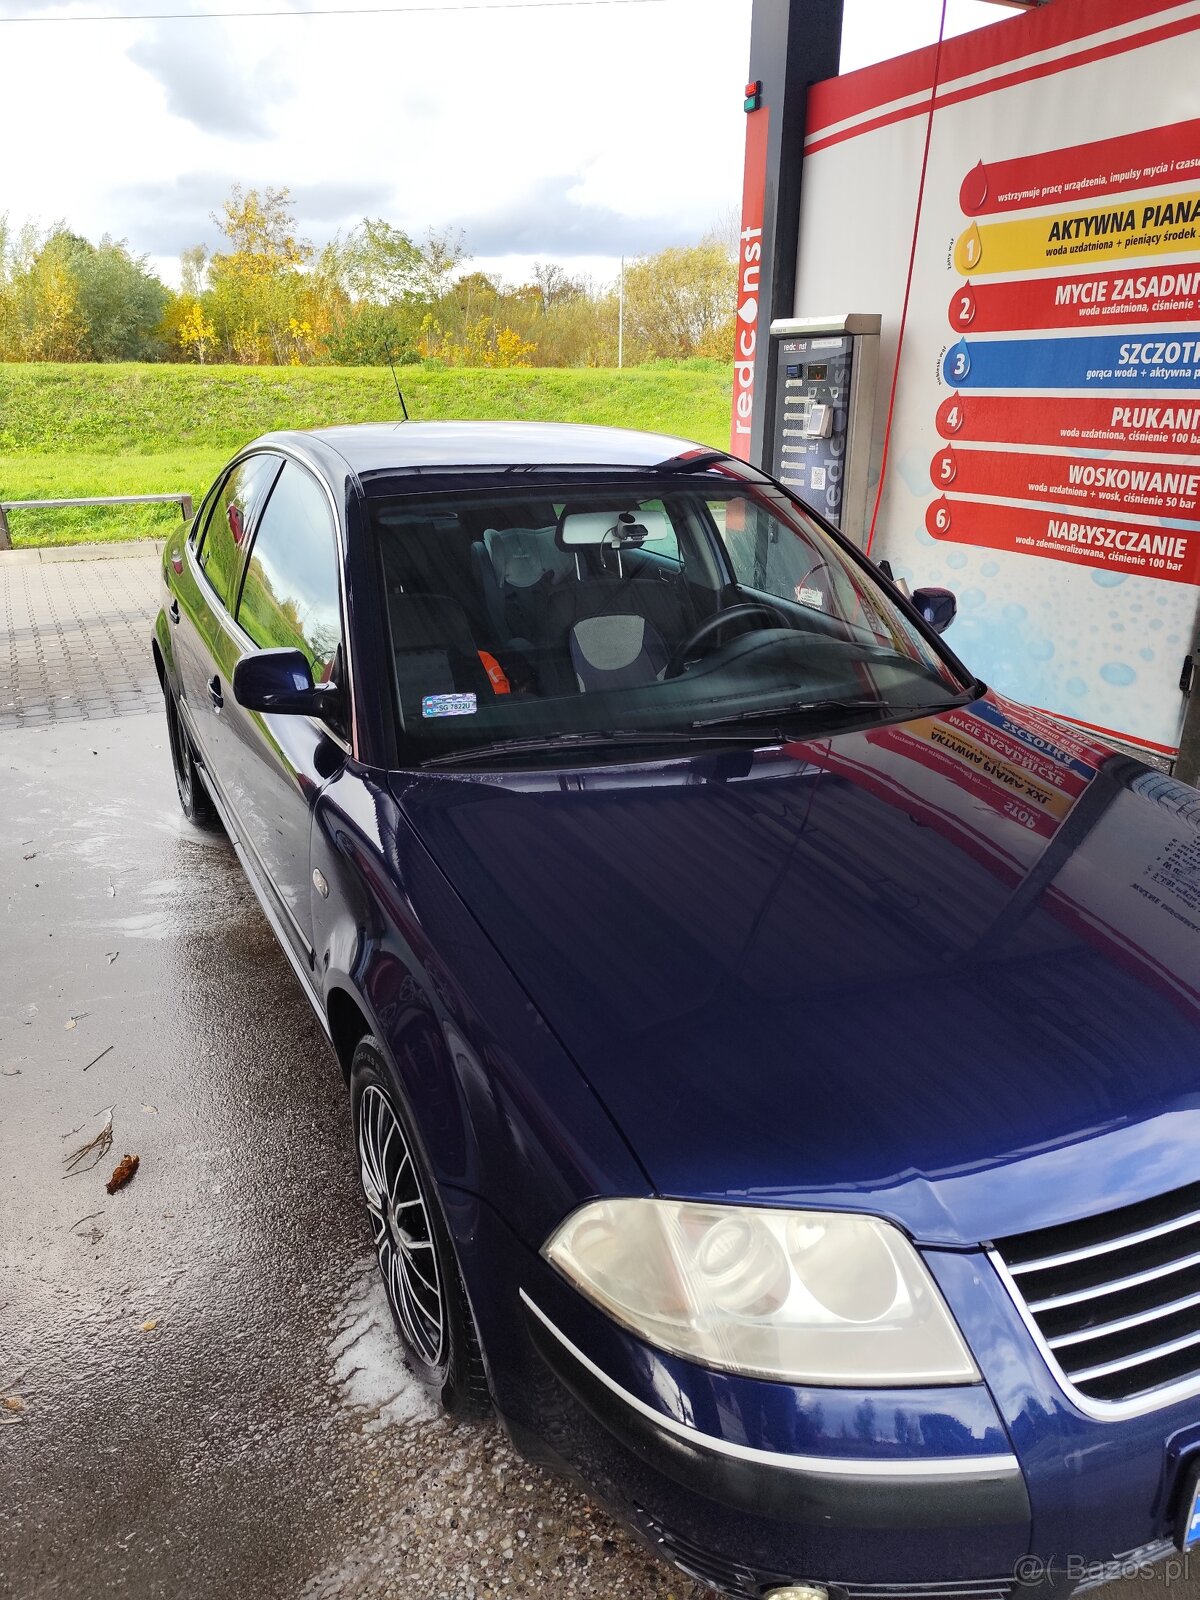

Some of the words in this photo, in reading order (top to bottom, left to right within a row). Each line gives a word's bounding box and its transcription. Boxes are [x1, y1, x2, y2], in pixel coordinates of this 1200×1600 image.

[997, 187, 1040, 202] wstrzymuje
[1041, 186, 1062, 197] pracę
[1064, 175, 1108, 192] urządzenia,
[1110, 168, 1141, 183] impulsy
[1143, 162, 1168, 178] mycia
[1170, 160, 1174, 171] i
[1048, 209, 1136, 242] AKTYWNA
[965, 239, 974, 261] 1
[1046, 247, 1067, 256] woda
[1070, 239, 1113, 254] uzdatniona
[1116, 239, 1122, 247] +
[1125, 233, 1161, 249] pieniący
[1163, 227, 1196, 241] środek
[1055, 281, 1108, 305] MYCIE
[960, 298, 970, 320] 2
[1079, 305, 1099, 316] woda
[1102, 302, 1149, 315] uzdatniona,
[1152, 298, 1194, 311] ciśnienie
[954, 353, 965, 375] 3
[1086, 369, 1112, 380] gorąca
[1114, 367, 1137, 378] woda
[1149, 367, 1191, 380] aktywna
[946, 407, 958, 427] 4
[1060, 428, 1080, 437] woda
[1081, 428, 1126, 441] uzdatniona,
[1128, 430, 1168, 442] ciśnienie
[1171, 433, 1188, 443] 100
[940, 458, 951, 478] 5
[1069, 464, 1200, 495] WOSKOWANIE
[1028, 482, 1047, 492] woda
[1049, 484, 1087, 497] uzdatniona
[1090, 490, 1096, 498] +
[1098, 490, 1121, 502] wosk,
[1123, 492, 1163, 505] ciśnienie
[1165, 497, 1177, 507] 50
[1180, 498, 1196, 509] bar
[936, 509, 946, 528] 6
[1047, 519, 1188, 559] NABŁYSZCZANIE
[1015, 535, 1035, 546] woda
[1036, 538, 1106, 560] zdemineralizowana,
[1108, 551, 1146, 566] ciśnienie
[1148, 557, 1165, 569] 100
[1167, 559, 1183, 572] bar
